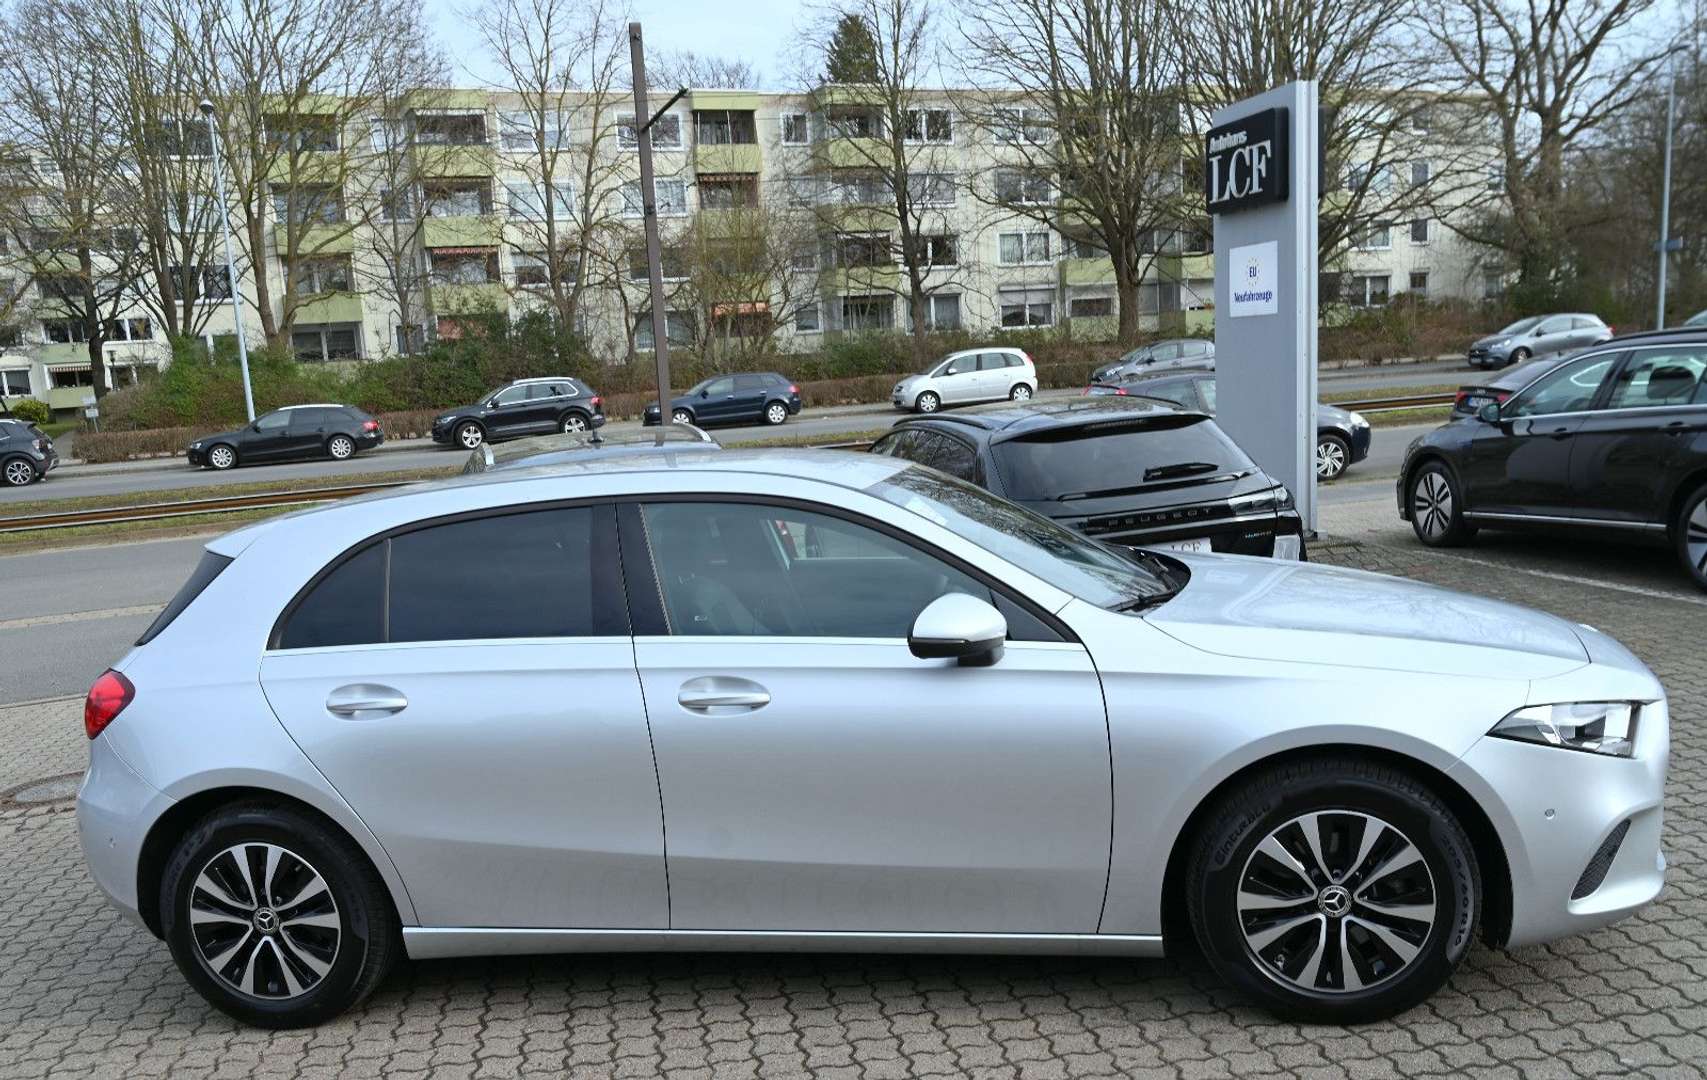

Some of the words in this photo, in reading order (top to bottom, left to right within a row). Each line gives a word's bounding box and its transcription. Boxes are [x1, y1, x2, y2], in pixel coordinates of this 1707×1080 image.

[1209, 140, 1271, 204] LCF
[1249, 266, 1257, 278] EU
[1233, 290, 1273, 303] Neufahrzeuge
